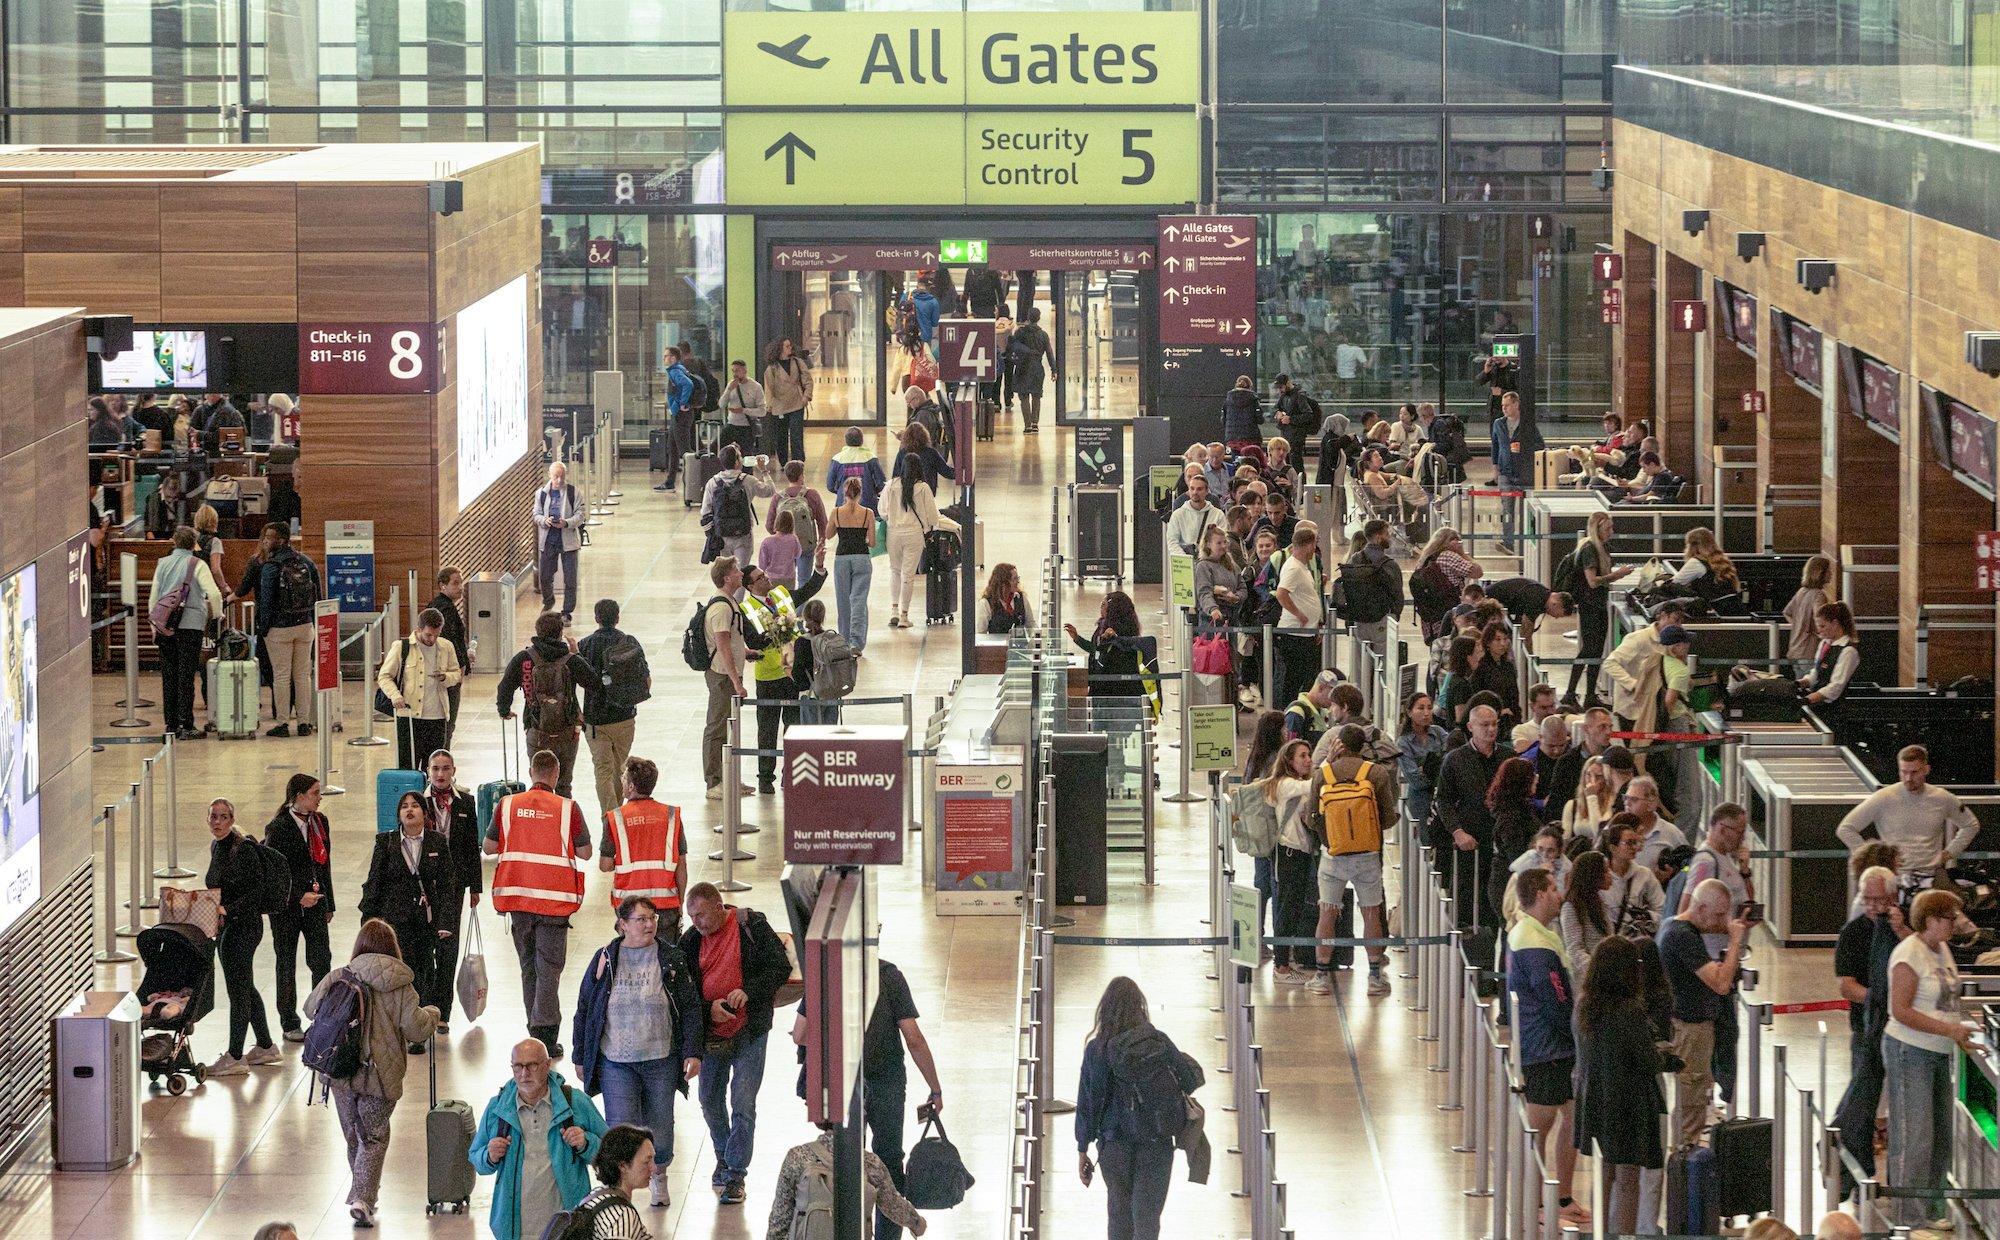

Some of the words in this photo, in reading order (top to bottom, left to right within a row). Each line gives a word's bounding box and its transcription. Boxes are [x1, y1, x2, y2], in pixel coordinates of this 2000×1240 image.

[859, 28, 948, 84] All
[981, 32, 1158, 84] Gates
[981, 127, 1088, 156] Security
[1121, 129, 1155, 185] 5
[981, 162, 1079, 185] Control
[1182, 223, 1203, 233] Alle
[1205, 224, 1234, 233] Gates
[1182, 235, 1193, 243] All
[1194, 235, 1217, 243] Gates
[792, 250, 820, 258] Abflug
[875, 250, 911, 258] Check-in
[913, 250, 919, 258] 9
[1029, 249, 1112, 257] Sicherheitskontrolle
[1114, 249, 1120, 257] 5
[1069, 258, 1094, 266] Security
[1182, 285, 1226, 295] Check-in
[1182, 297, 1189, 305] 9
[310, 330, 372, 343] Check-in
[389, 330, 423, 379] 8
[960, 331, 992, 376] 4
[80, 542, 89, 618] 6
[824, 751, 857, 766] BER
[824, 771, 896, 791] Runway
[940, 775, 964, 786] BER
[516, 808, 536, 819] BER
[626, 816, 646, 827] BER
[794, 830, 812, 839] Nur
[814, 829, 831, 839] mit
[833, 829, 896, 841] Reservierung
[793, 842, 811, 851] Only
[813, 842, 829, 850] with
[831, 842, 873, 850] reservation
